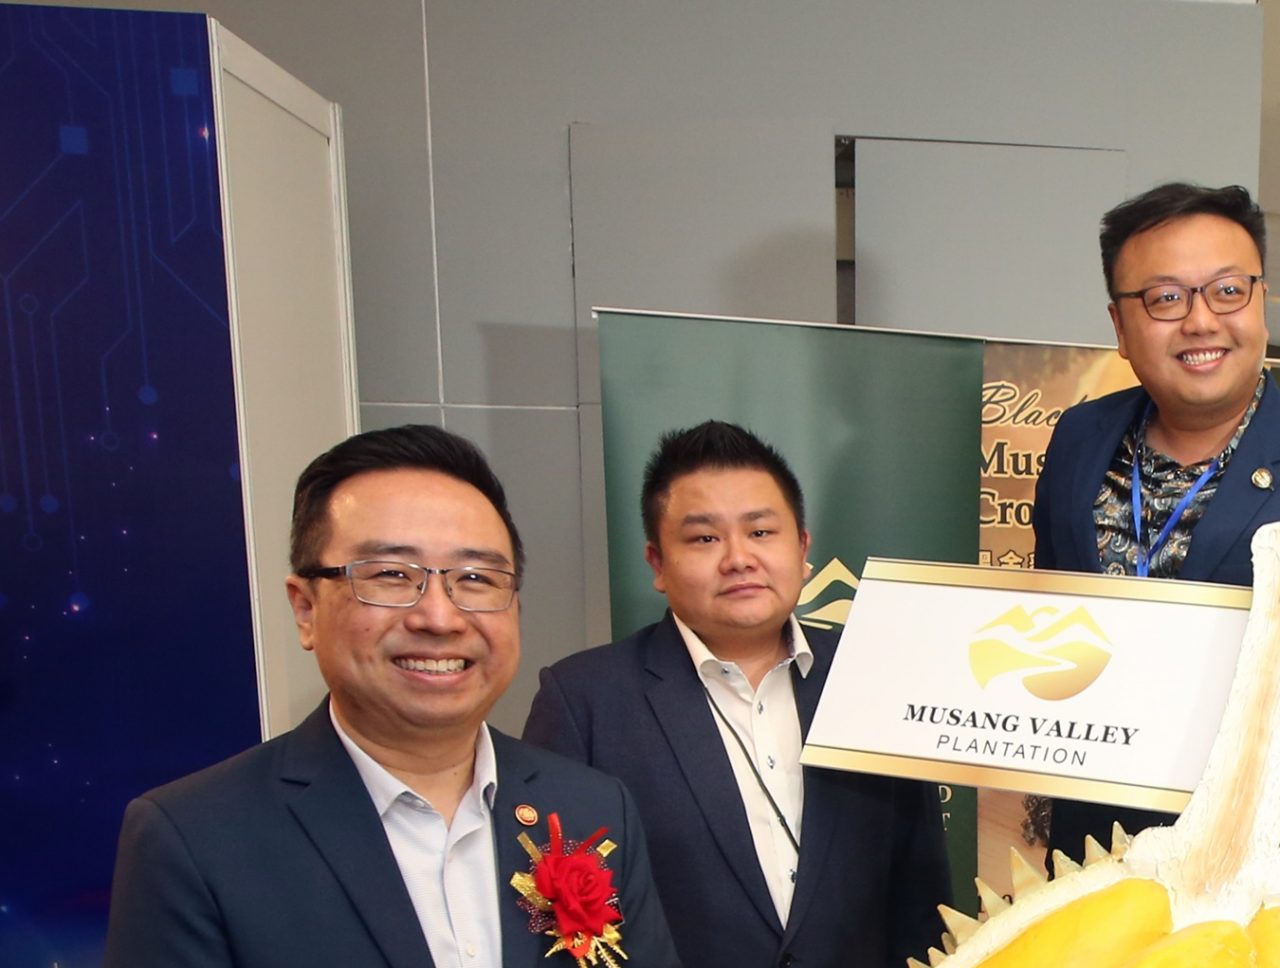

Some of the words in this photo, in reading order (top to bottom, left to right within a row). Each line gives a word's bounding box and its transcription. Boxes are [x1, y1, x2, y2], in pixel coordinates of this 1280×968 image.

[982, 382, 1062, 426] Blac
[980, 491, 1033, 526] Cro
[903, 704, 1020, 732] MUSANG
[1029, 717, 1140, 745] VALLEY
[936, 735, 1087, 766] PLANTATION
